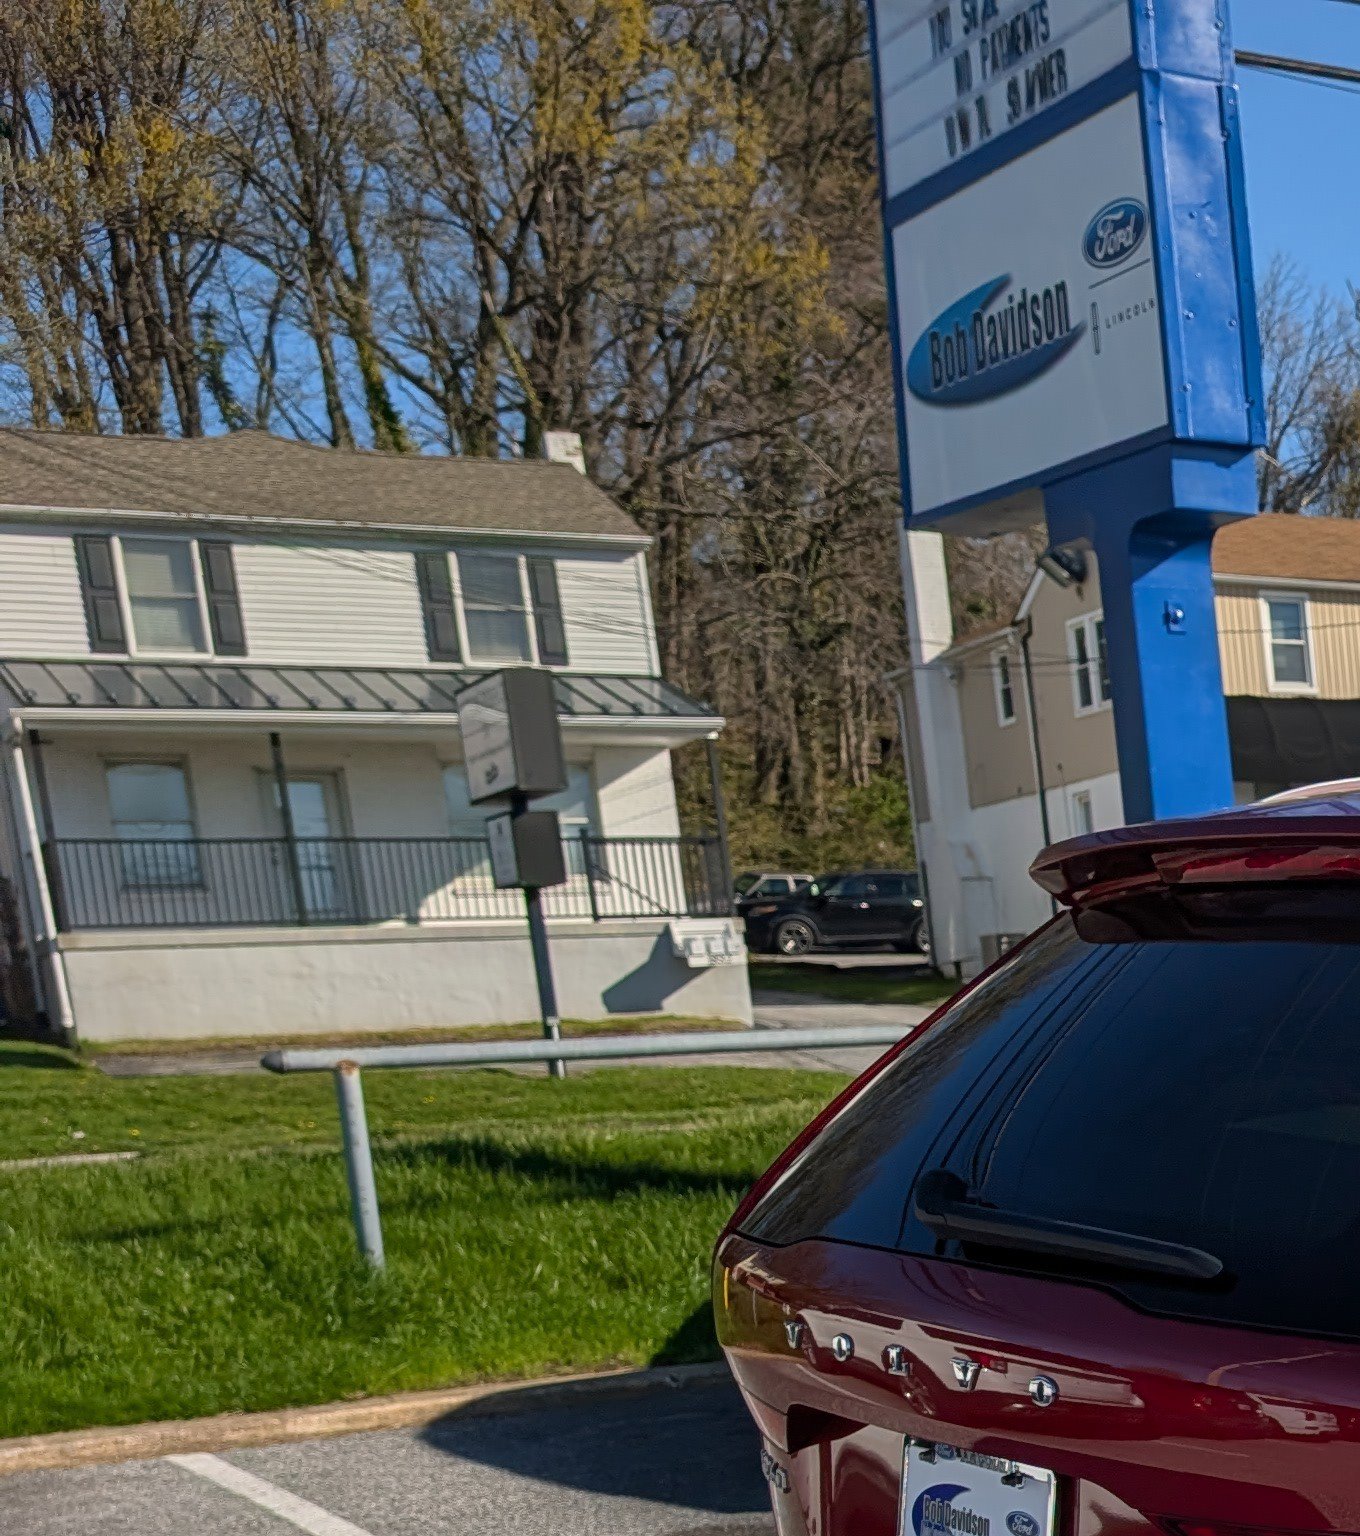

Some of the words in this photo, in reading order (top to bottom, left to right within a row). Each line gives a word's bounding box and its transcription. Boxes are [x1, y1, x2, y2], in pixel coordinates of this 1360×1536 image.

[979, 0, 1050, 81] PAYMENTS
[1094, 210, 1136, 260] Ford
[928, 321, 969, 390] Bob
[971, 279, 1071, 374] Davidson
[1104, 298, 1156, 330] LINCOLN
[783, 1318, 1060, 1408] VOLVO
[923, 1495, 944, 1523] Bob
[1010, 1514, 1034, 1536] Ford
